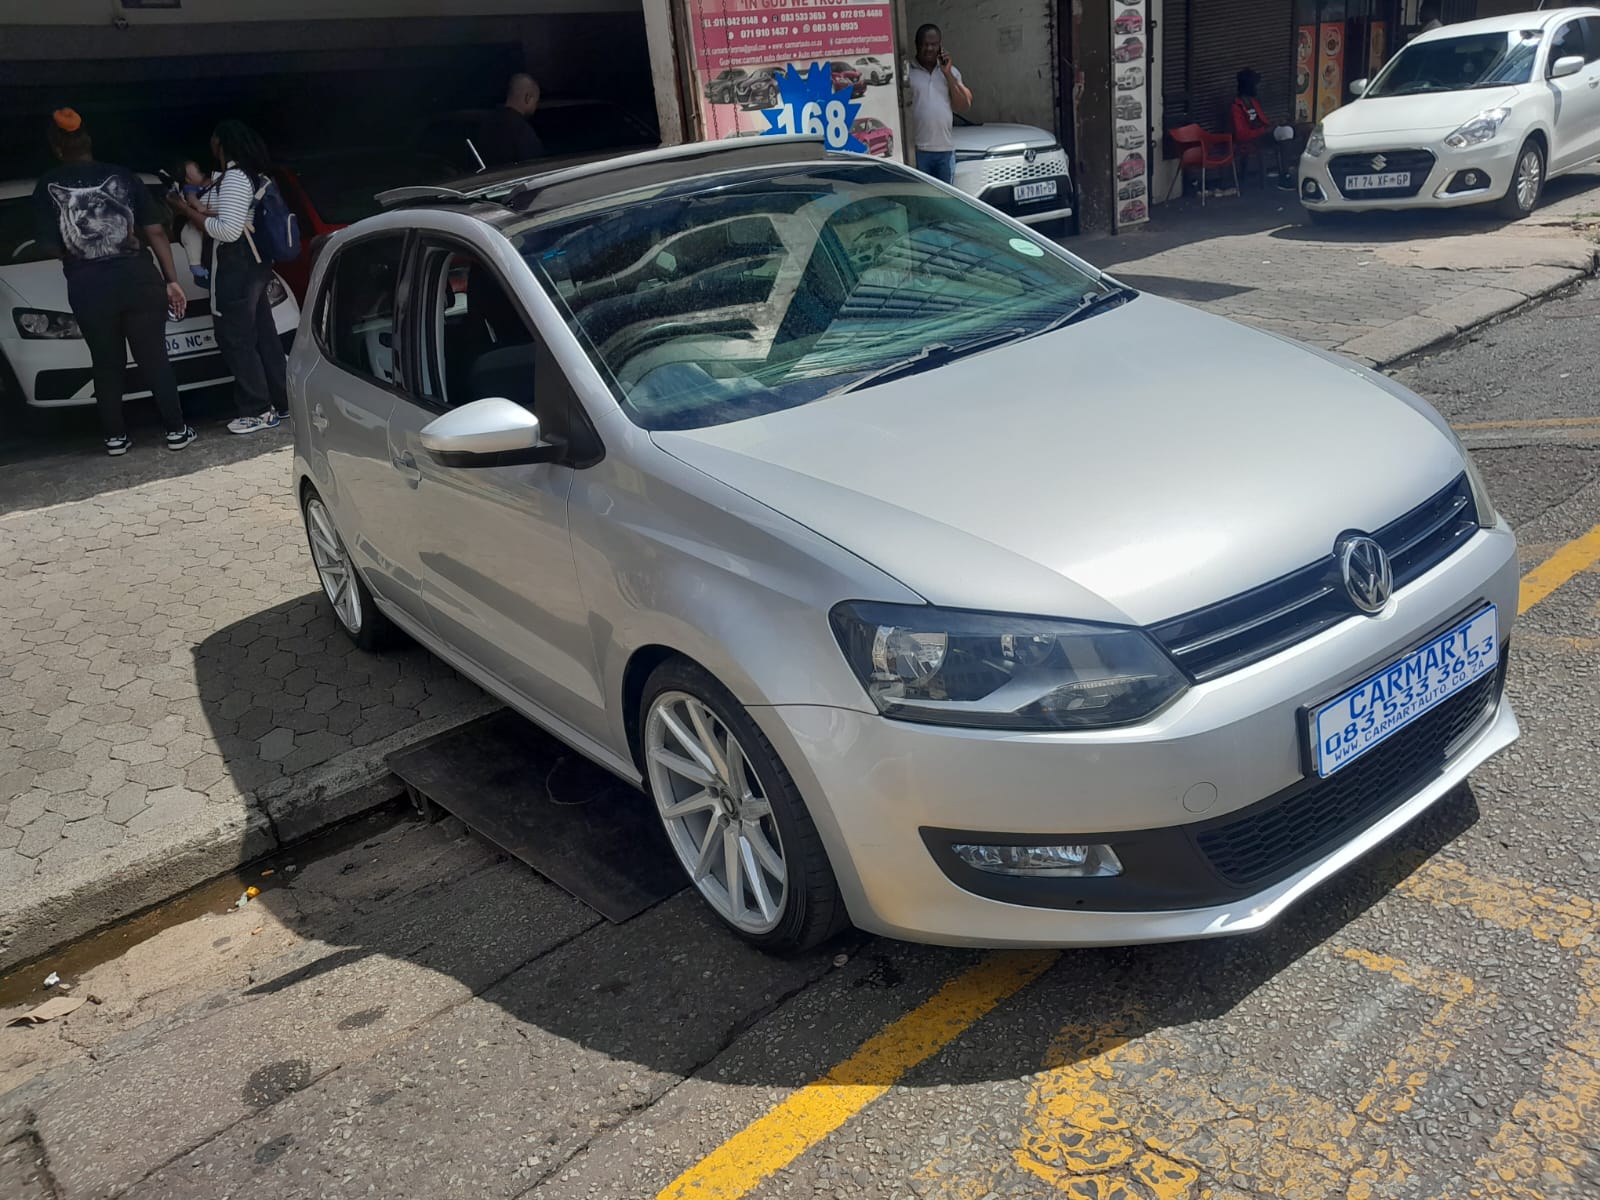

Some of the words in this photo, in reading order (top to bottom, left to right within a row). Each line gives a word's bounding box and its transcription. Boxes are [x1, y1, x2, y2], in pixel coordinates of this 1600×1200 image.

[777, 100, 849, 148] 168
[1363, 175, 1373, 187] 74
[1397, 174, 1408, 185] GP
[185, 335, 203, 348] NC
[1325, 710, 1375, 756] 083
[1383, 677, 1429, 717] 533
[1437, 635, 1494, 684] 3653
[1349, 624, 1472, 720] CARMART
